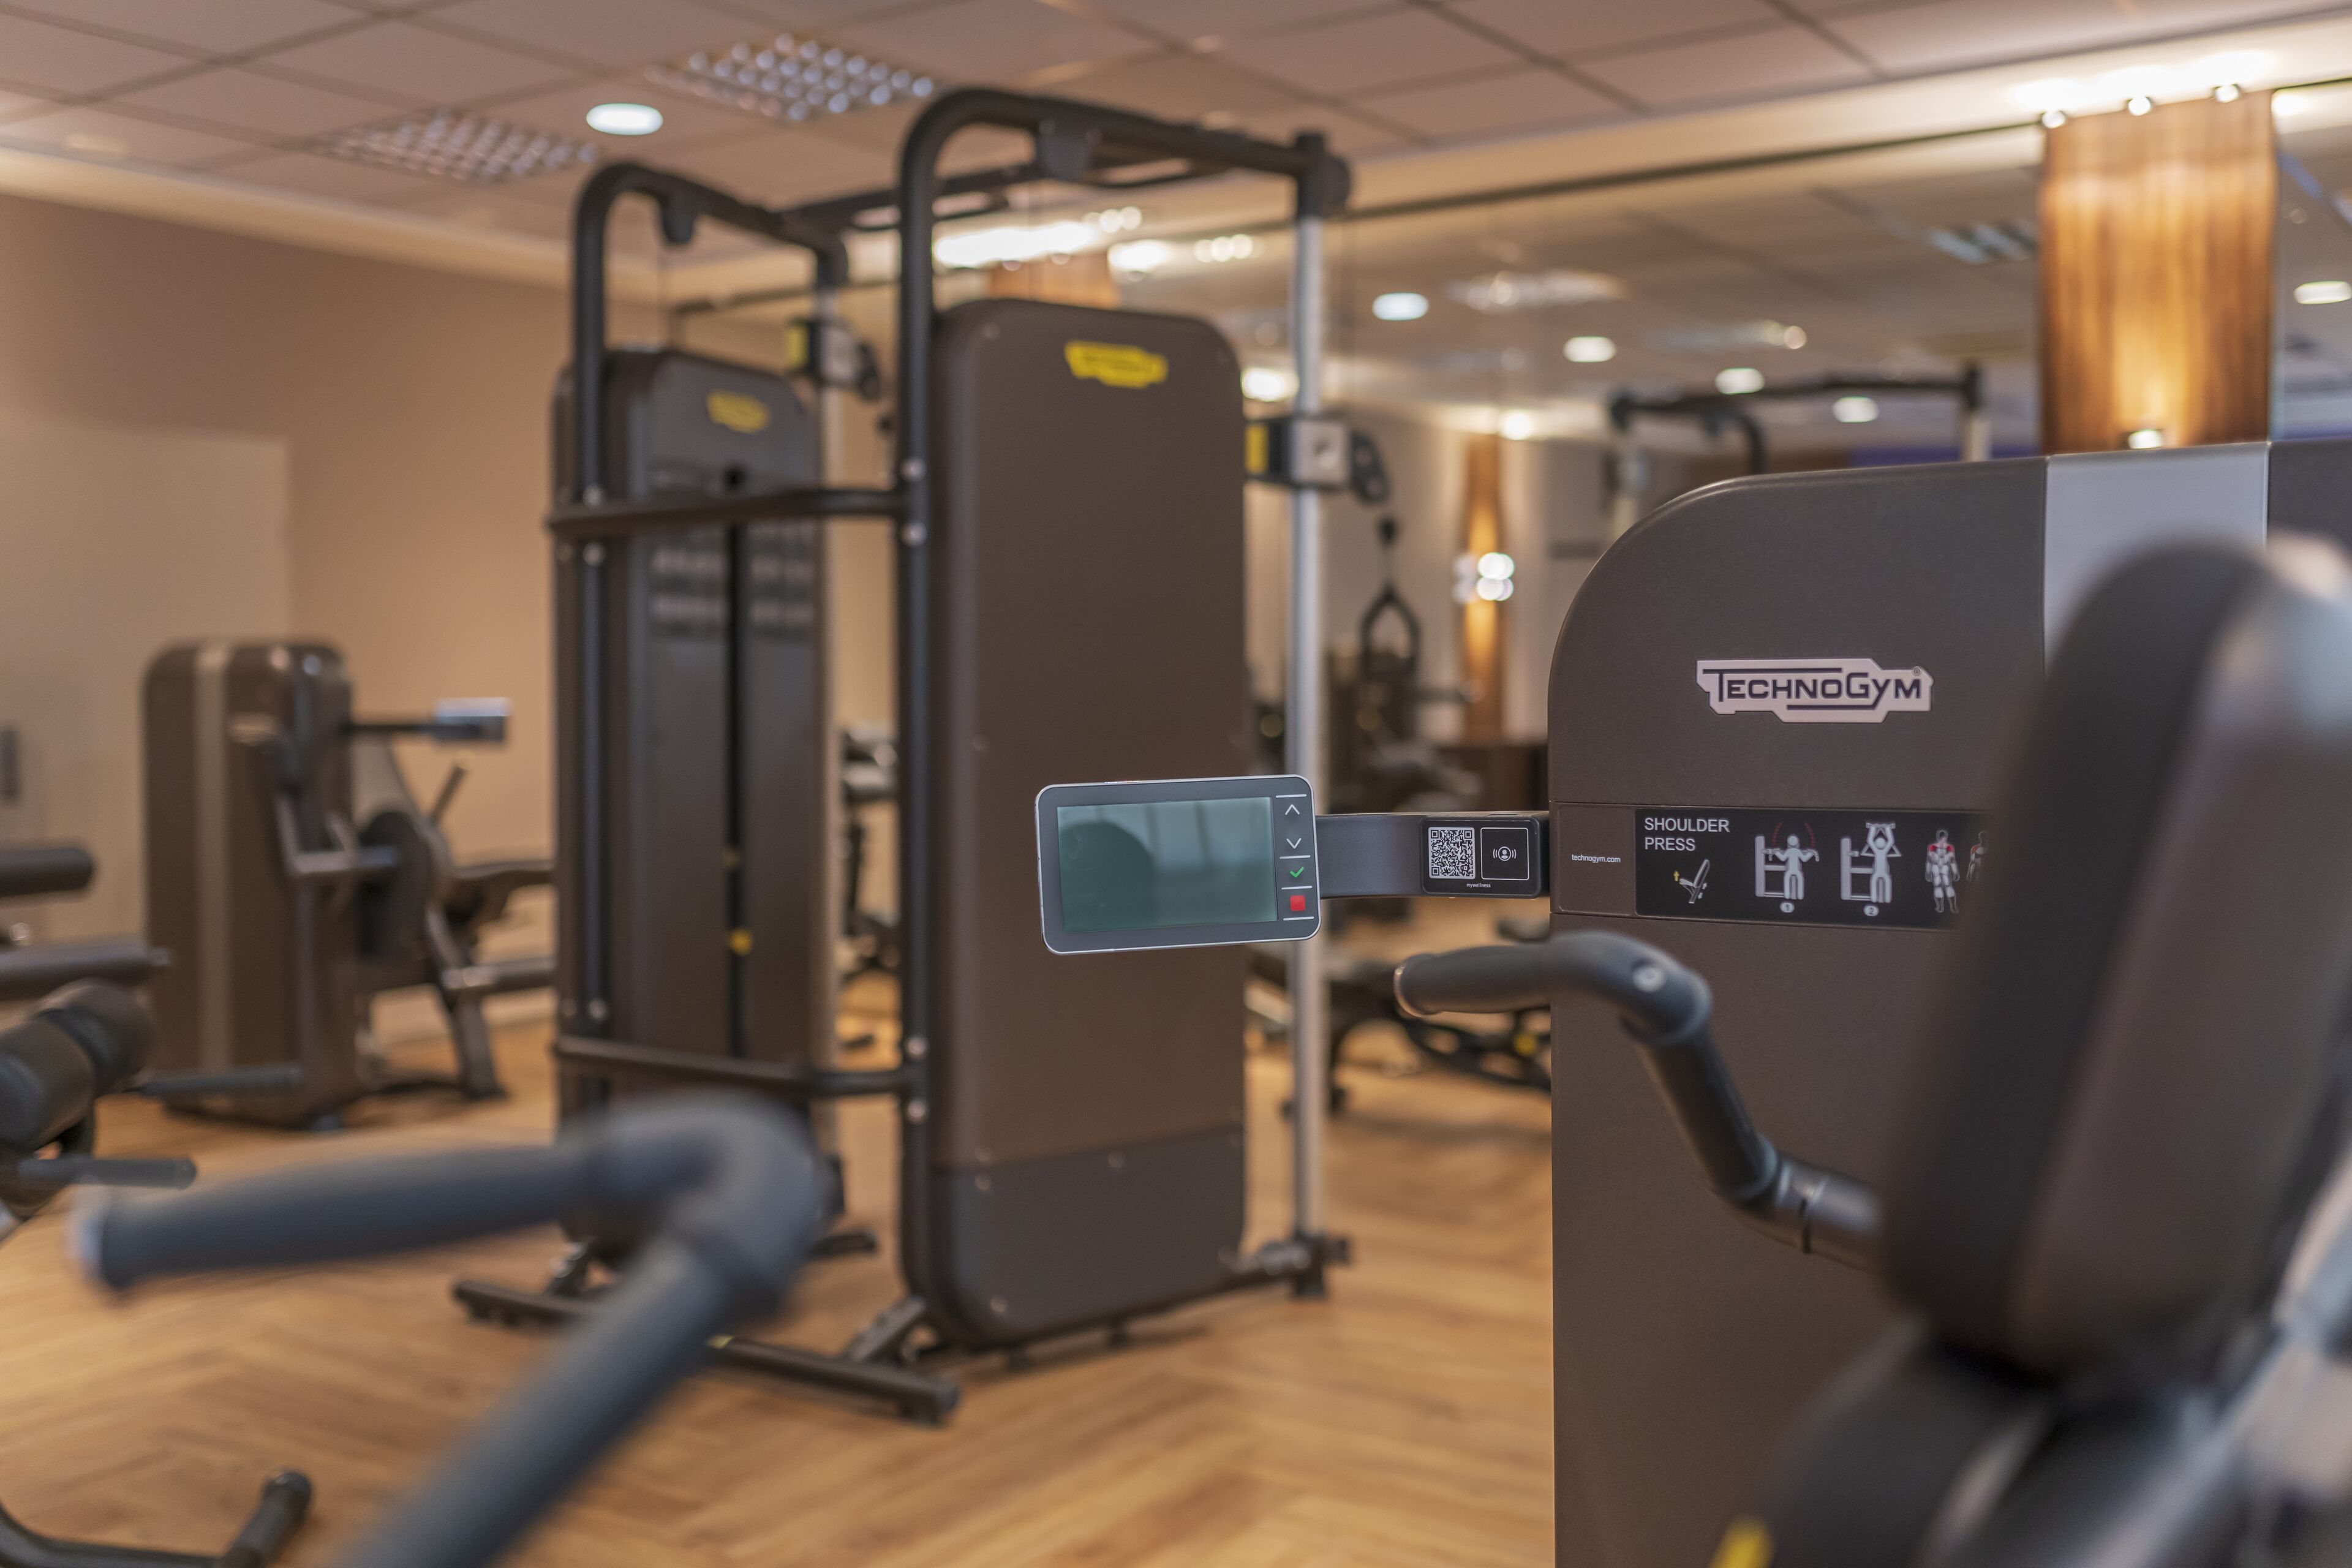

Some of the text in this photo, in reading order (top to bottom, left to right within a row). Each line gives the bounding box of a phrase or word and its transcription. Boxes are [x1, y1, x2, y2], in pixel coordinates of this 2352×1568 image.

[1644, 818, 1730, 833] SHOULDER
[1644, 837, 1696, 851] PRESS
[1571, 854, 1621, 864] technogym.com
